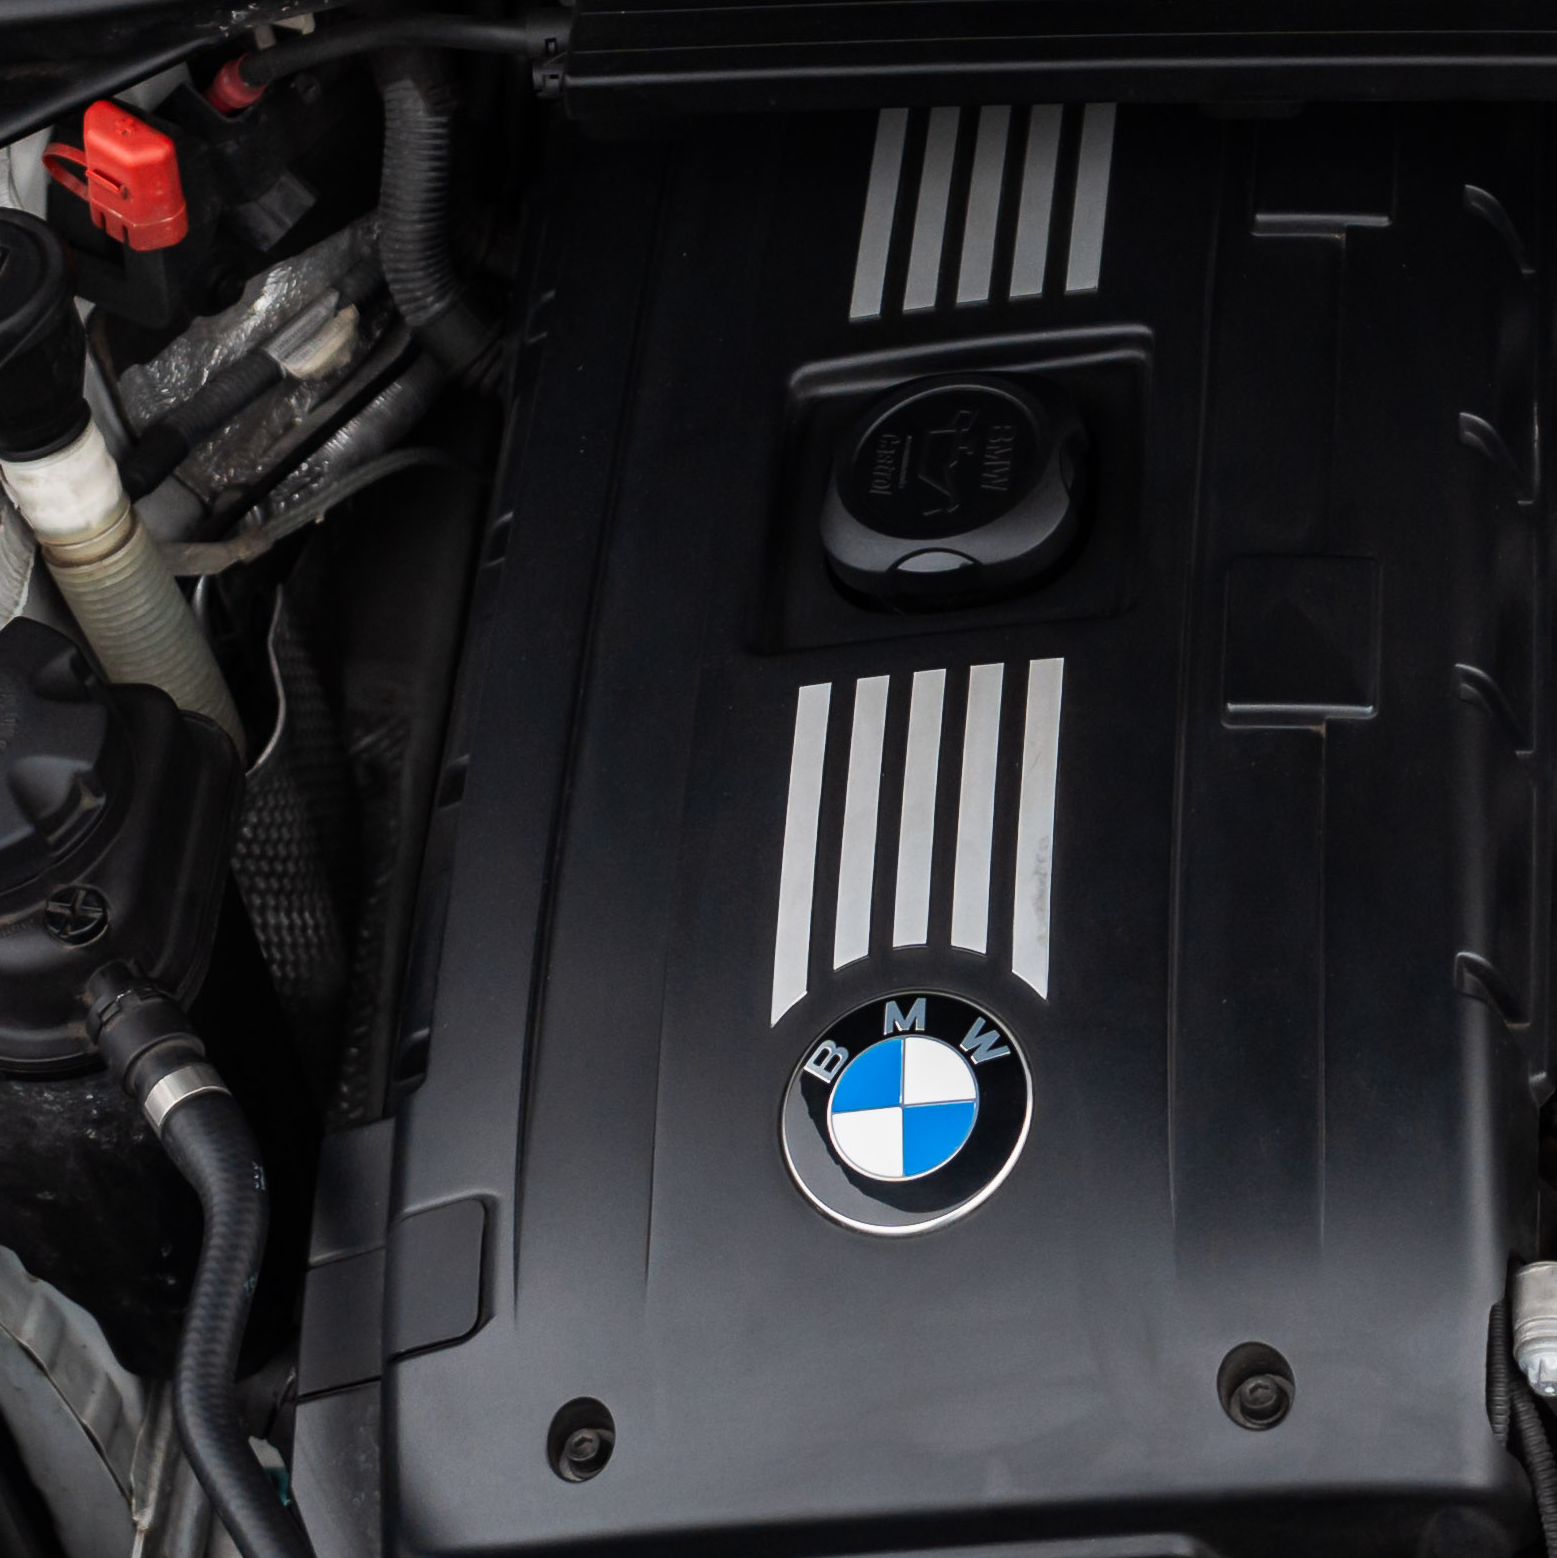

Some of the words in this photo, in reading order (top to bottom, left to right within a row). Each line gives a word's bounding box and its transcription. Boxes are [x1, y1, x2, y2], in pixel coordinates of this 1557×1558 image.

[868, 433, 901, 495] Castrol
[980, 424, 1016, 490] BMW
[802, 998, 1010, 1084] BMW
